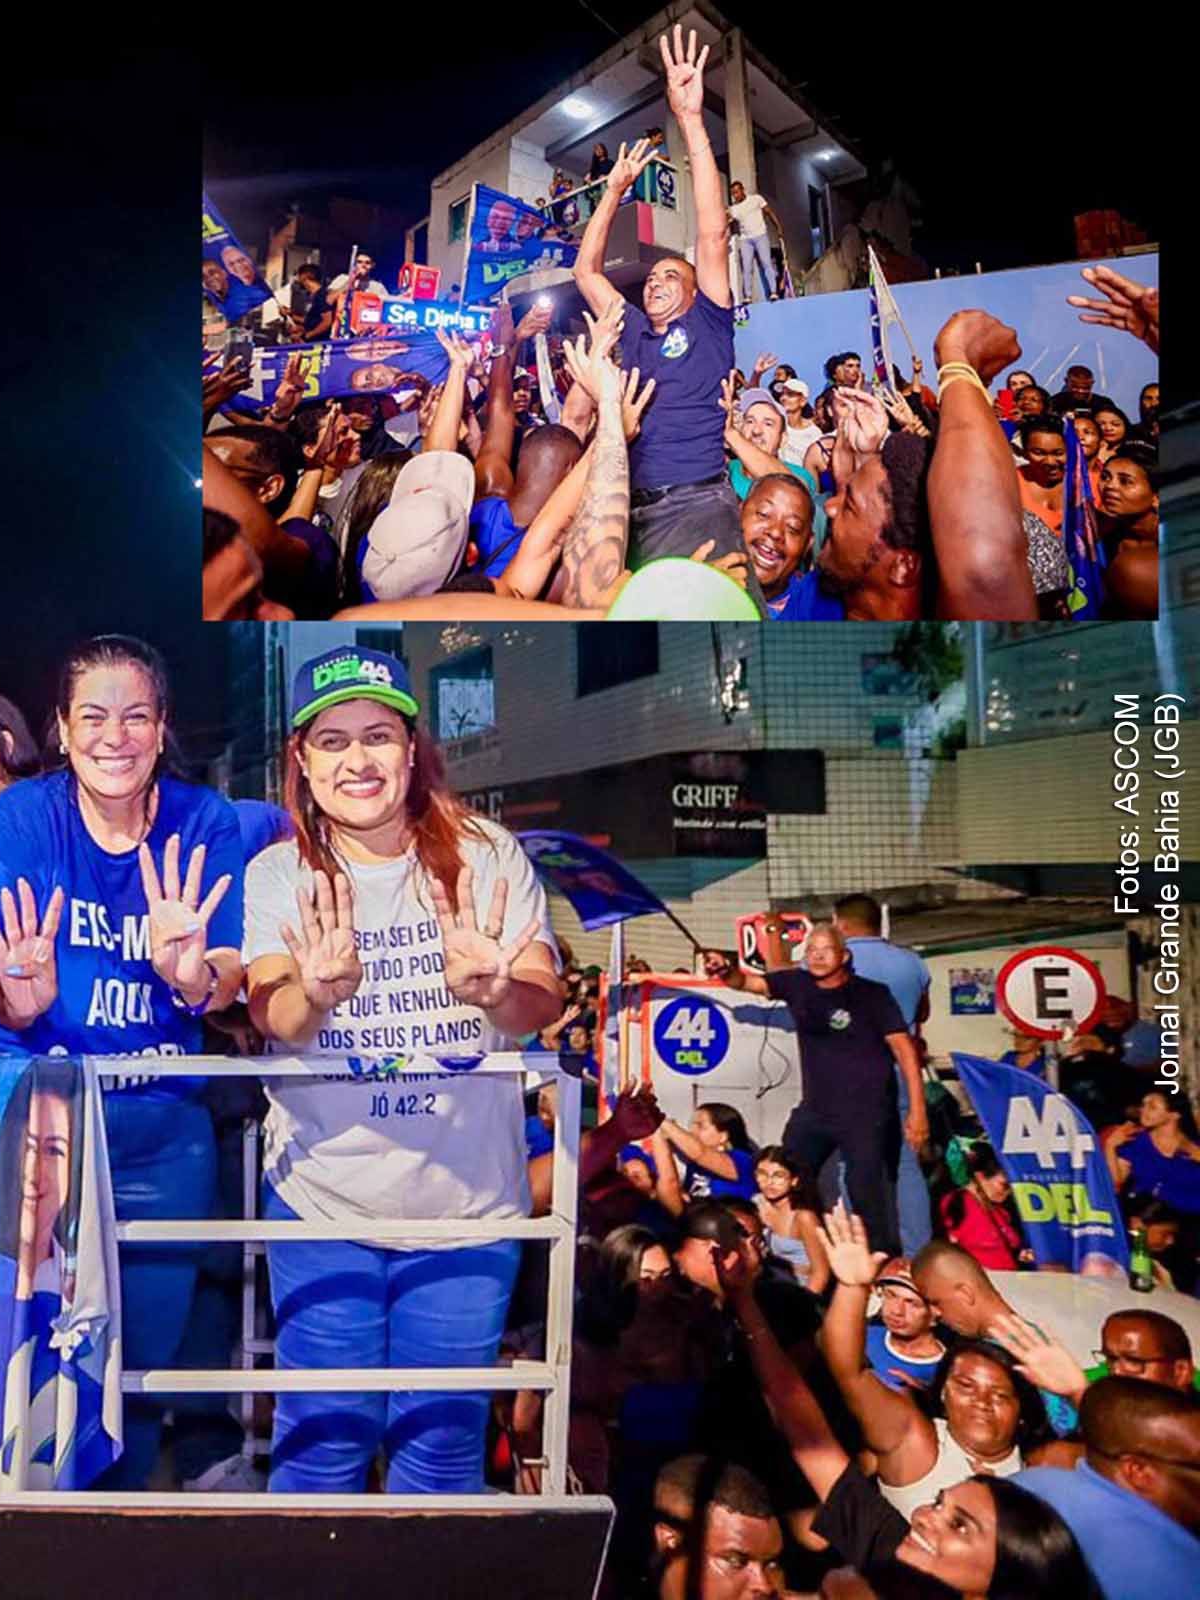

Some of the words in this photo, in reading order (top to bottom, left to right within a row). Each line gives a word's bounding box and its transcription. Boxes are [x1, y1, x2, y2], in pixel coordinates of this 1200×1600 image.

[387, 305, 417, 324] Se
[313, 659, 361, 690] DEL
[672, 784, 739, 808] GRIFF
[70, 898, 151, 961] EIS-M
[389, 925, 414, 949] SEI
[417, 919, 439, 943] EU
[363, 957, 404, 982] TUDO
[409, 951, 445, 977] POD
[350, 993, 381, 1019] QUE
[1033, 967, 1073, 1019] E
[319, 1029, 354, 1049] DOS
[361, 1023, 406, 1049] SEUS
[412, 1017, 482, 1047] PLANOS
[663, 1007, 716, 1048] 44
[370, 1091, 389, 1119] JÓ
[395, 1092, 436, 1117] 42.2
[1002, 1093, 1096, 1169] 44
[1012, 1182, 1113, 1225] DEL
